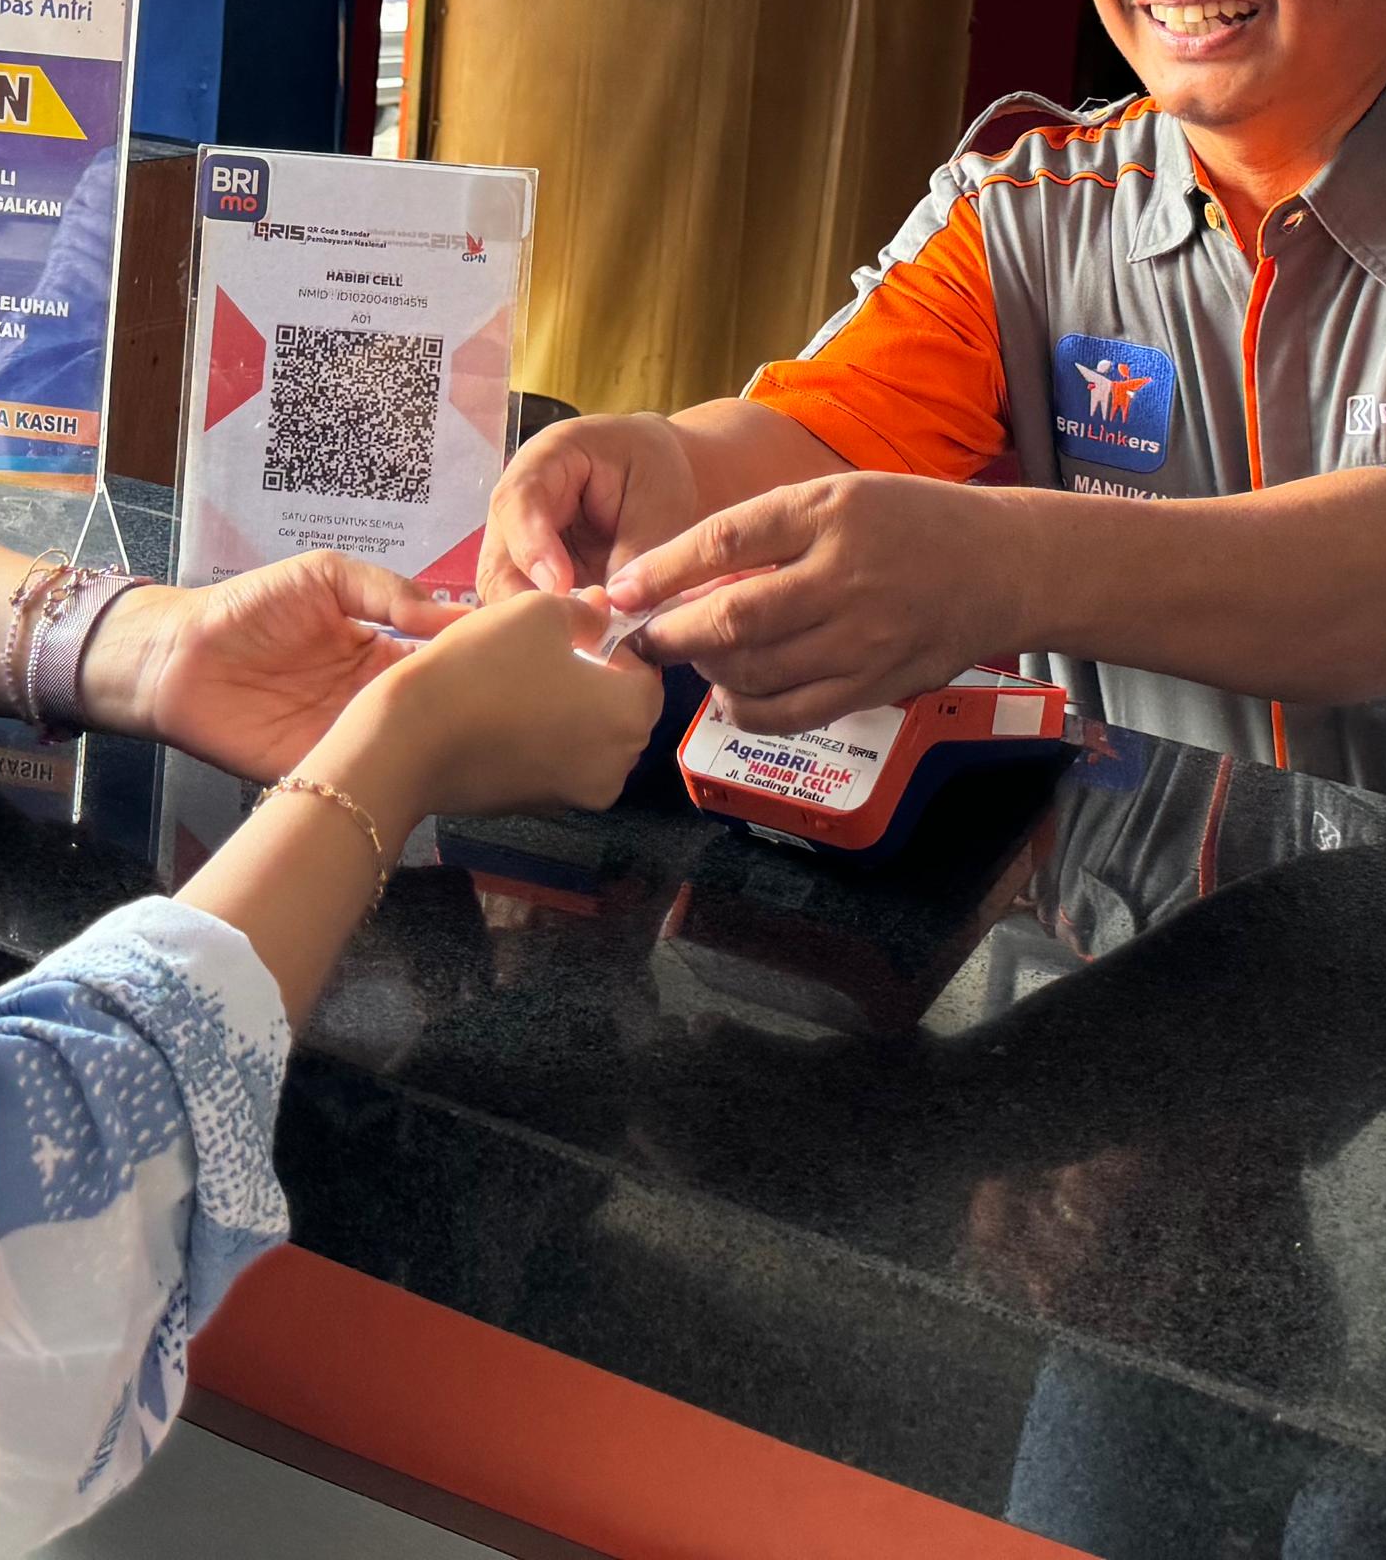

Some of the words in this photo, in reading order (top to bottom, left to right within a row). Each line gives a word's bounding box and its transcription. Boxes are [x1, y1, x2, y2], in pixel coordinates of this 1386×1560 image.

[212, 166, 259, 195] BRI
[220, 196, 257, 212] mo
[255, 223, 306, 242] QRIS
[341, 229, 370, 238] Standar
[462, 253, 486, 263] GPN
[327, 271, 369, 285] HABIBI
[372, 275, 402, 287] CELL
[299, 289, 328, 300] NMID
[351, 314, 371, 324] A01
[16, 411, 78, 435] KASIH
[1056, 415, 1160, 454] BRILinkers
[282, 512, 307, 522] SATU
[310, 515, 332, 524] QRIS
[334, 516, 367, 527] UNTUK
[370, 520, 404, 530] SEMUA
[725, 740, 852, 784] AgenBRILink
[744, 774, 789, 795] Gading
[793, 788, 825, 803] Watu
